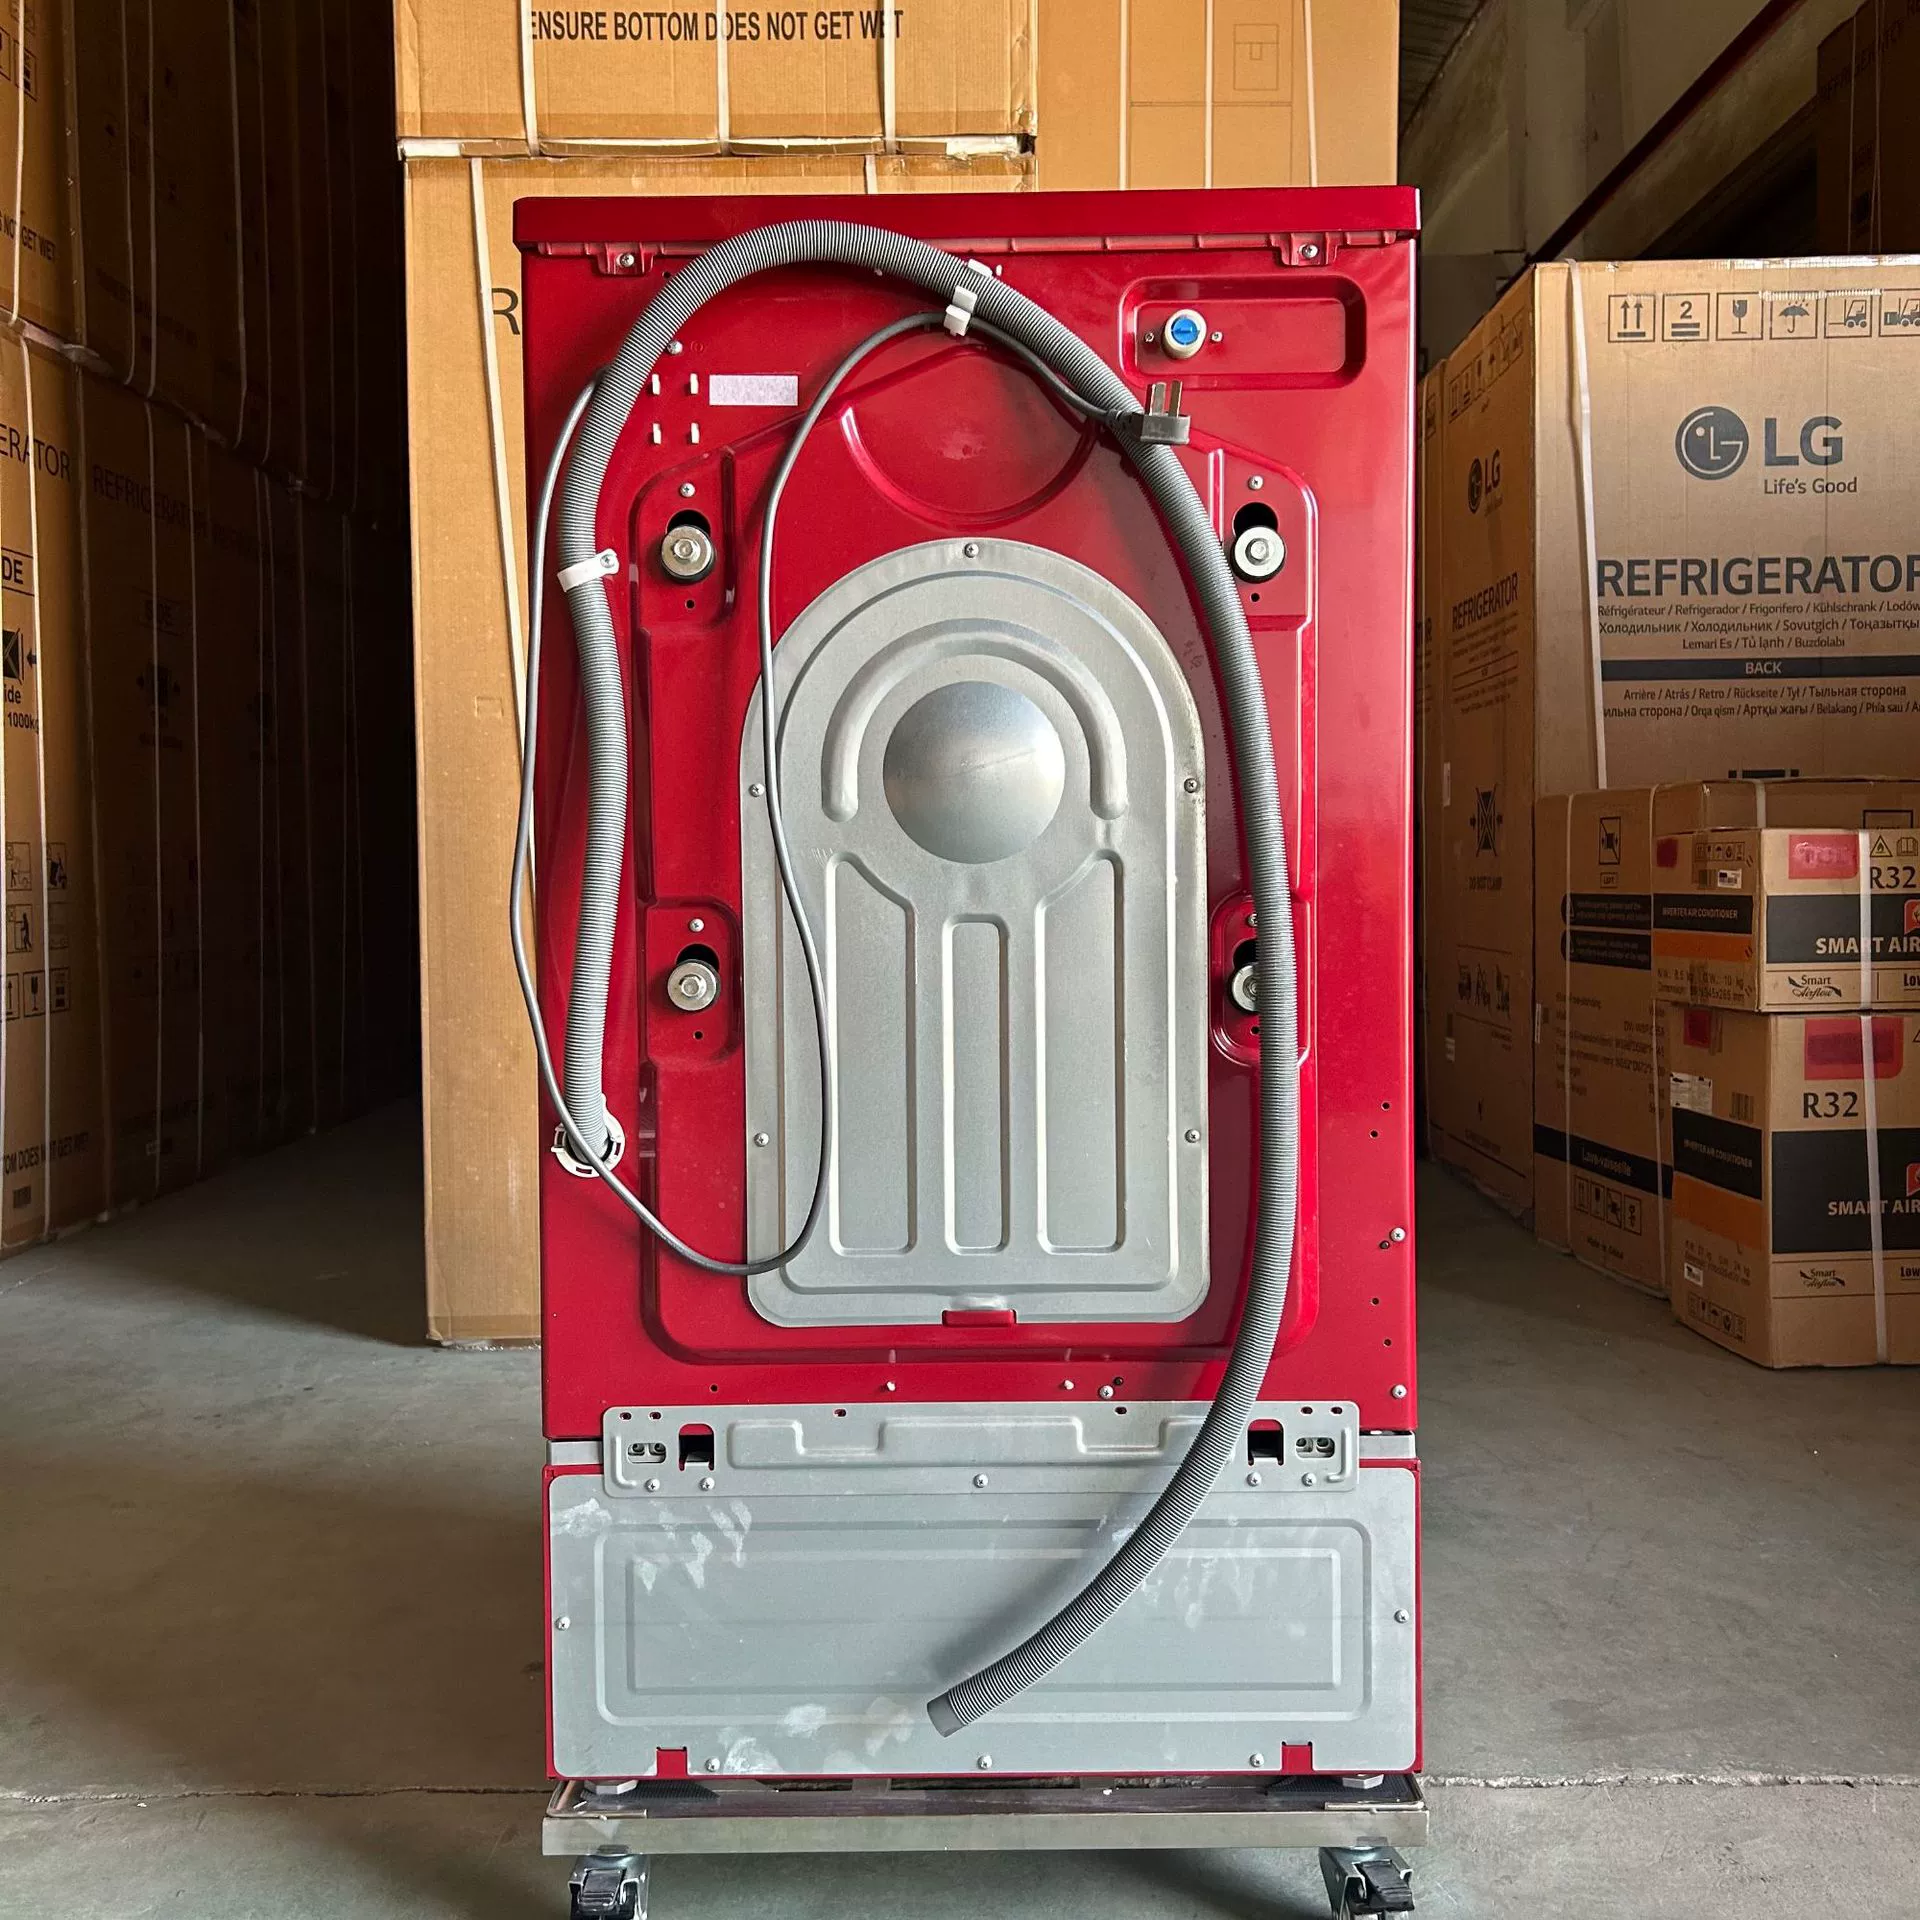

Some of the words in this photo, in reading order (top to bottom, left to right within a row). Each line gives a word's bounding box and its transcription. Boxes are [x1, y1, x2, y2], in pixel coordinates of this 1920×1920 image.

[613, 11, 699, 41] BOTTOM
[766, 11, 809, 41] NOT
[814, 10, 854, 40] GET
[1764, 415, 1844, 467] LG
[1763, 478, 1807, 495] Life's
[1812, 476, 1858, 494] Good
[1452, 572, 1519, 633] REFRIGERATOR
[1675, 603, 1739, 618] Refrigerador
[1750, 602, 1804, 617] Frigorifero
[1813, 601, 1877, 613] Kühlschrank
[1599, 622, 1681, 636] Холодильник
[1691, 620, 1773, 634] Холодильник
[1782, 618, 1839, 634] Sovutgich
[1682, 638, 1717, 650] Lemari
[1719, 638, 1732, 649] Es
[1758, 636, 1785, 651] lạnh
[1745, 661, 1783, 675] BACK
[1623, 689, 1656, 701] Arrière
[1664, 688, 1690, 700] Atrás
[1699, 687, 1725, 699] Retro
[1733, 686, 1779, 699] Rückseite
[1809, 685, 1858, 697] Тыльная
[1860, 685, 1907, 700] сторона
[1639, 705, 1683, 720] сторона
[1714, 704, 1735, 718] qism
[1816, 702, 1858, 717] Belakang
[1870, 864, 1918, 890] R32
[1698, 908, 1739, 920] CONDITIONER
[1815, 935, 1885, 955] SMAT
[1801, 974, 1832, 987] Smart
[1802, 1092, 1859, 1119] R32
[1827, 1199, 1888, 1216] SMAT
[1810, 1268, 1836, 1278] Smart
